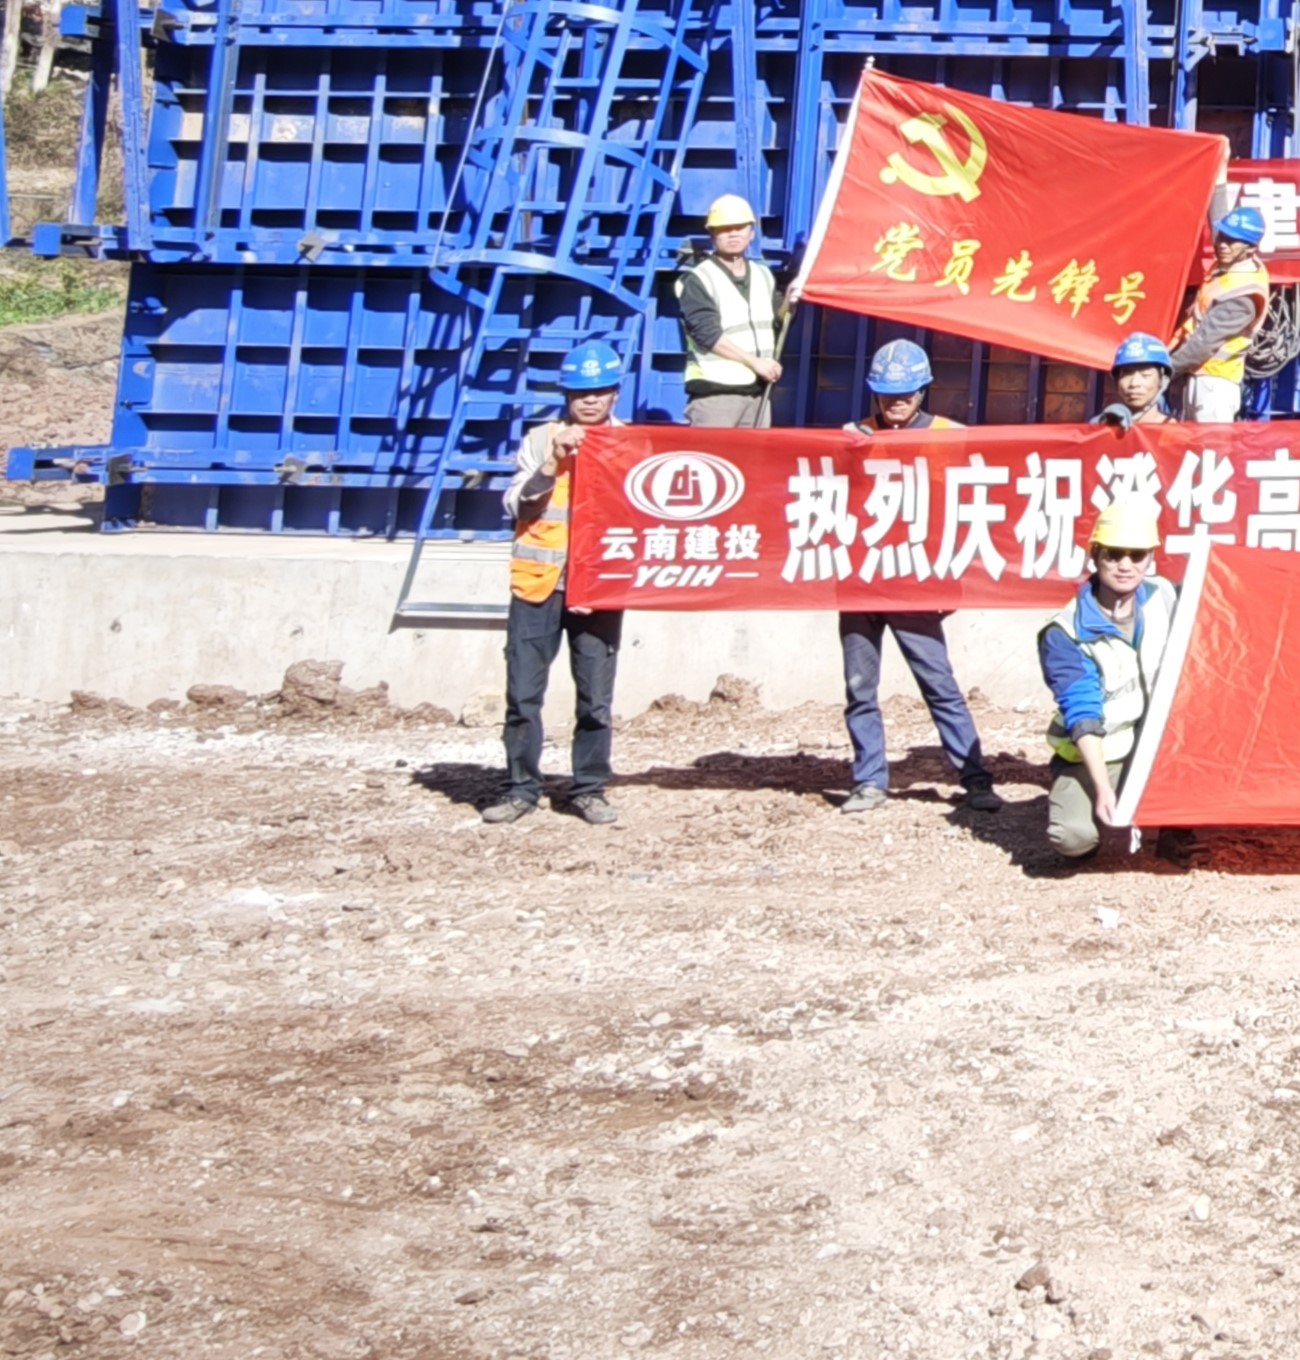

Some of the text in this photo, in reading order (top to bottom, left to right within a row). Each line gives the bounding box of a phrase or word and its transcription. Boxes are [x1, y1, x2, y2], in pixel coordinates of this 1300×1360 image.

[870, 222, 1147, 326] 党员先锋号
[600, 523, 762, 561] 云南建投
[633, 563, 725, 589] YCIH
